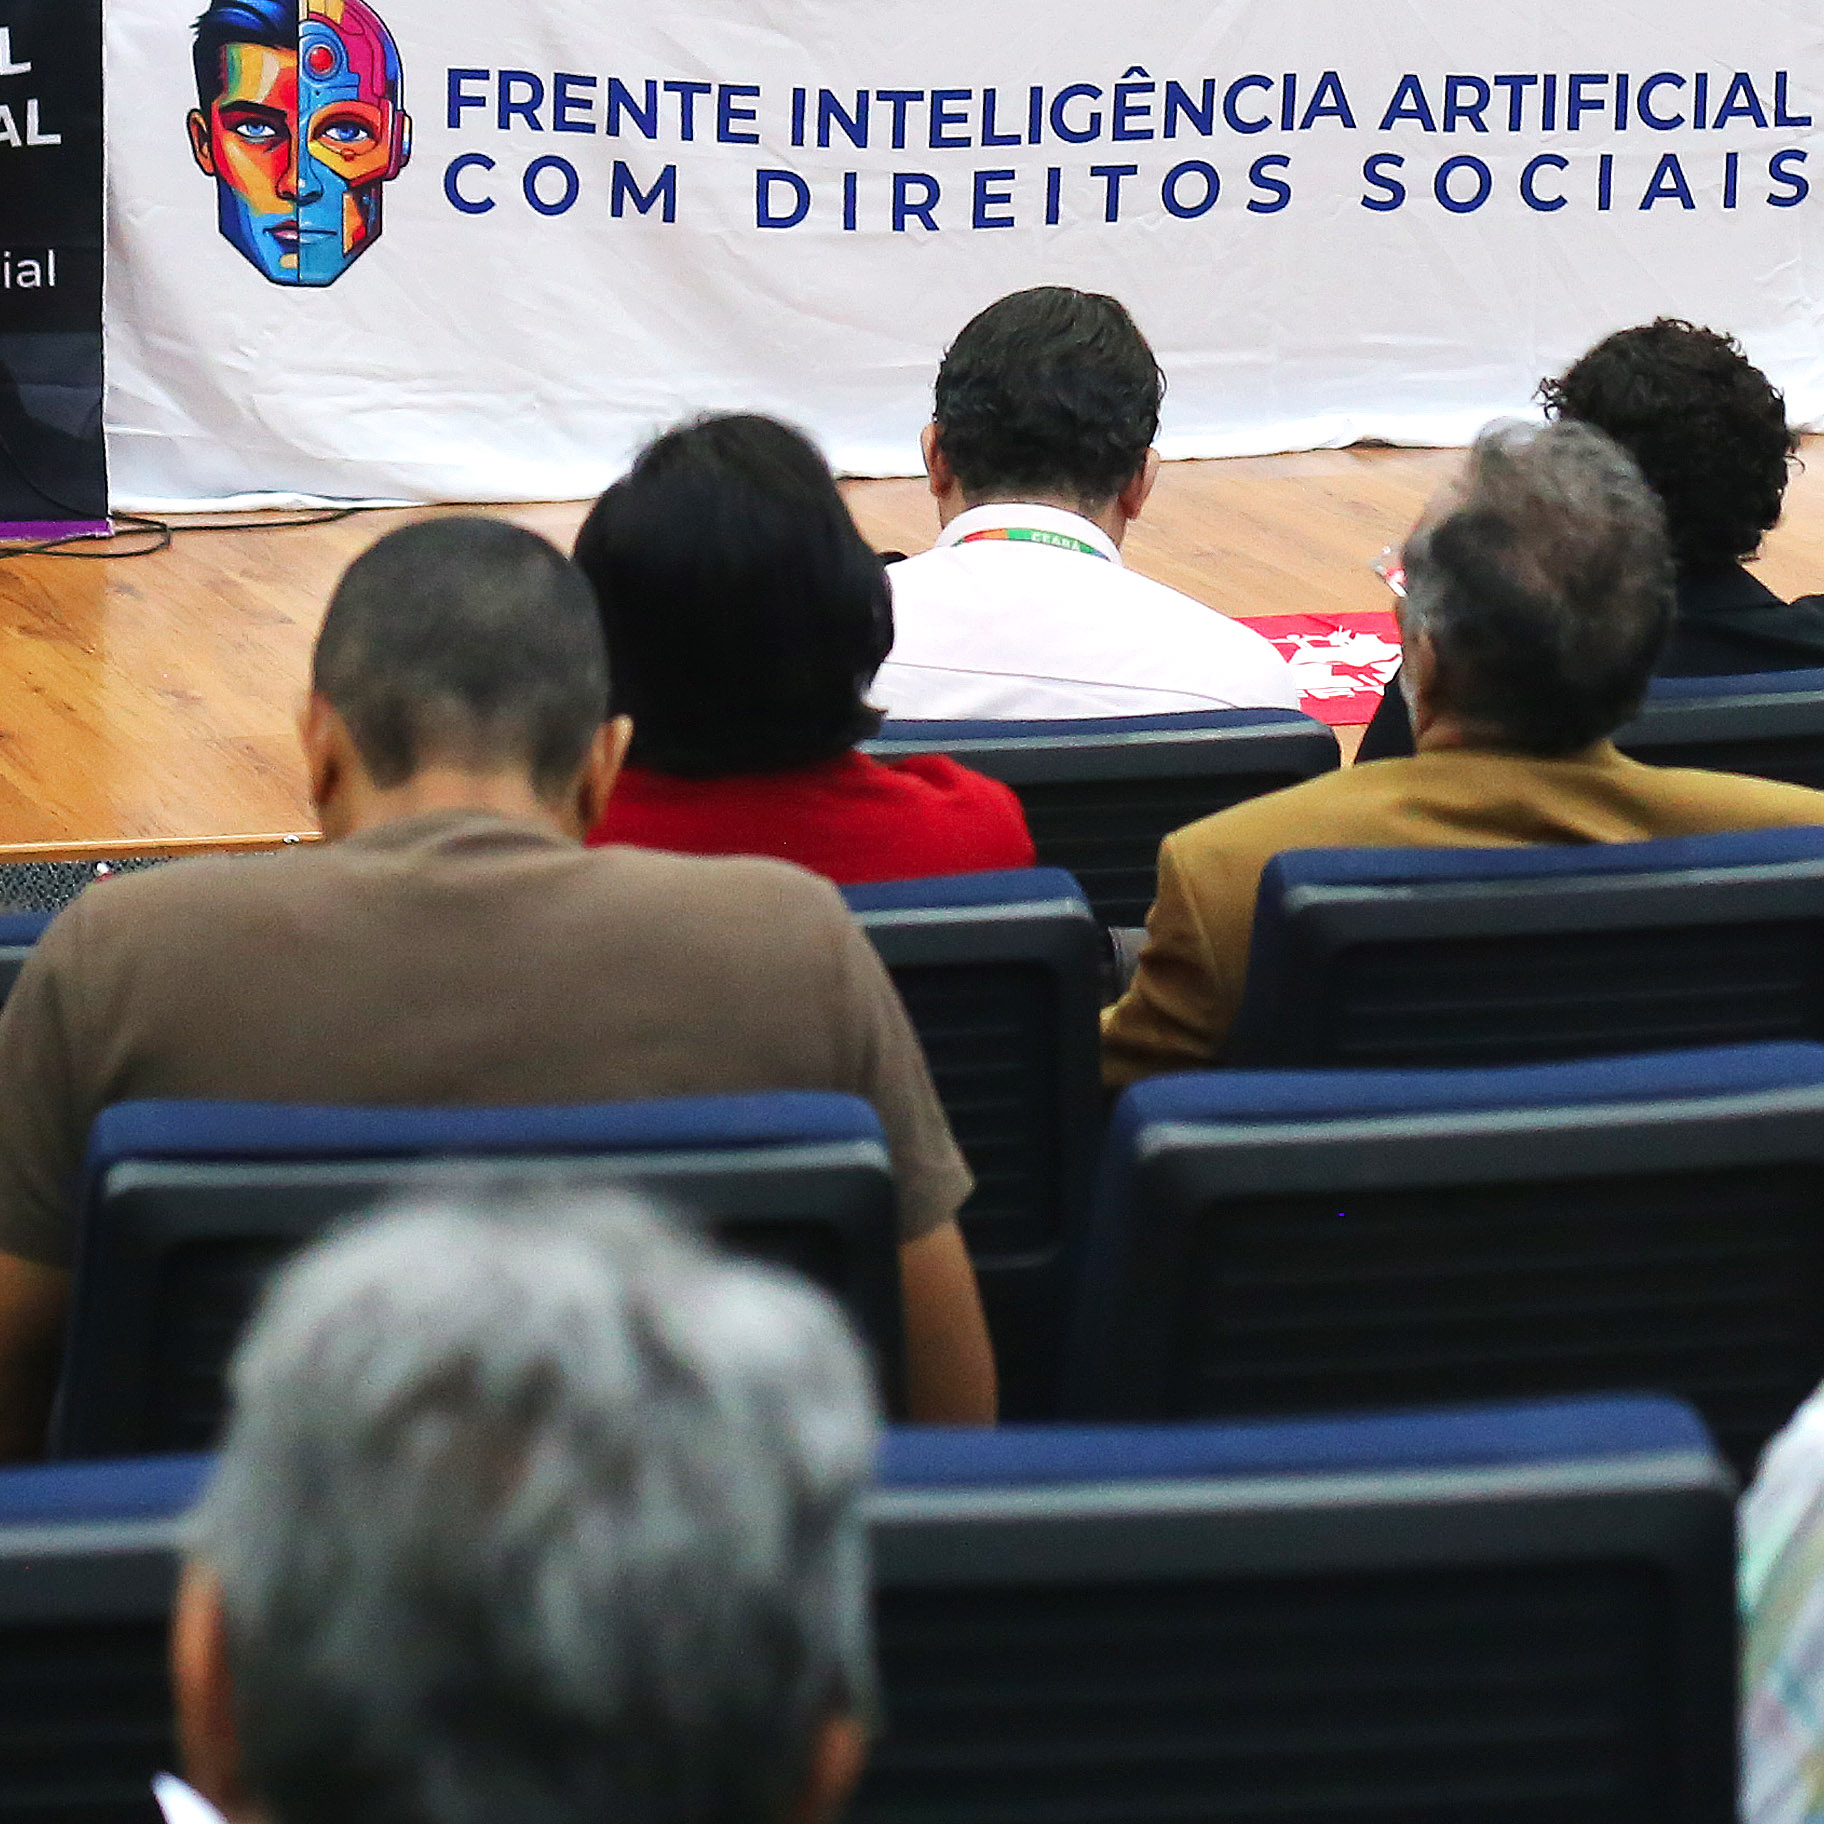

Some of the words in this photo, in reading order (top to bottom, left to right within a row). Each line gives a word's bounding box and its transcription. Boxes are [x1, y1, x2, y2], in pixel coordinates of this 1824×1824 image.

[445, 67, 761, 145] FRENTE
[791, 66, 1357, 150] INTELIGÊNCIA
[1379, 71, 1813, 133] ARTIFICIAL
[442, 152, 677, 225] COM
[755, 153, 1292, 232] DIREITOS
[1360, 150, 1810, 214] SOCIAIS
